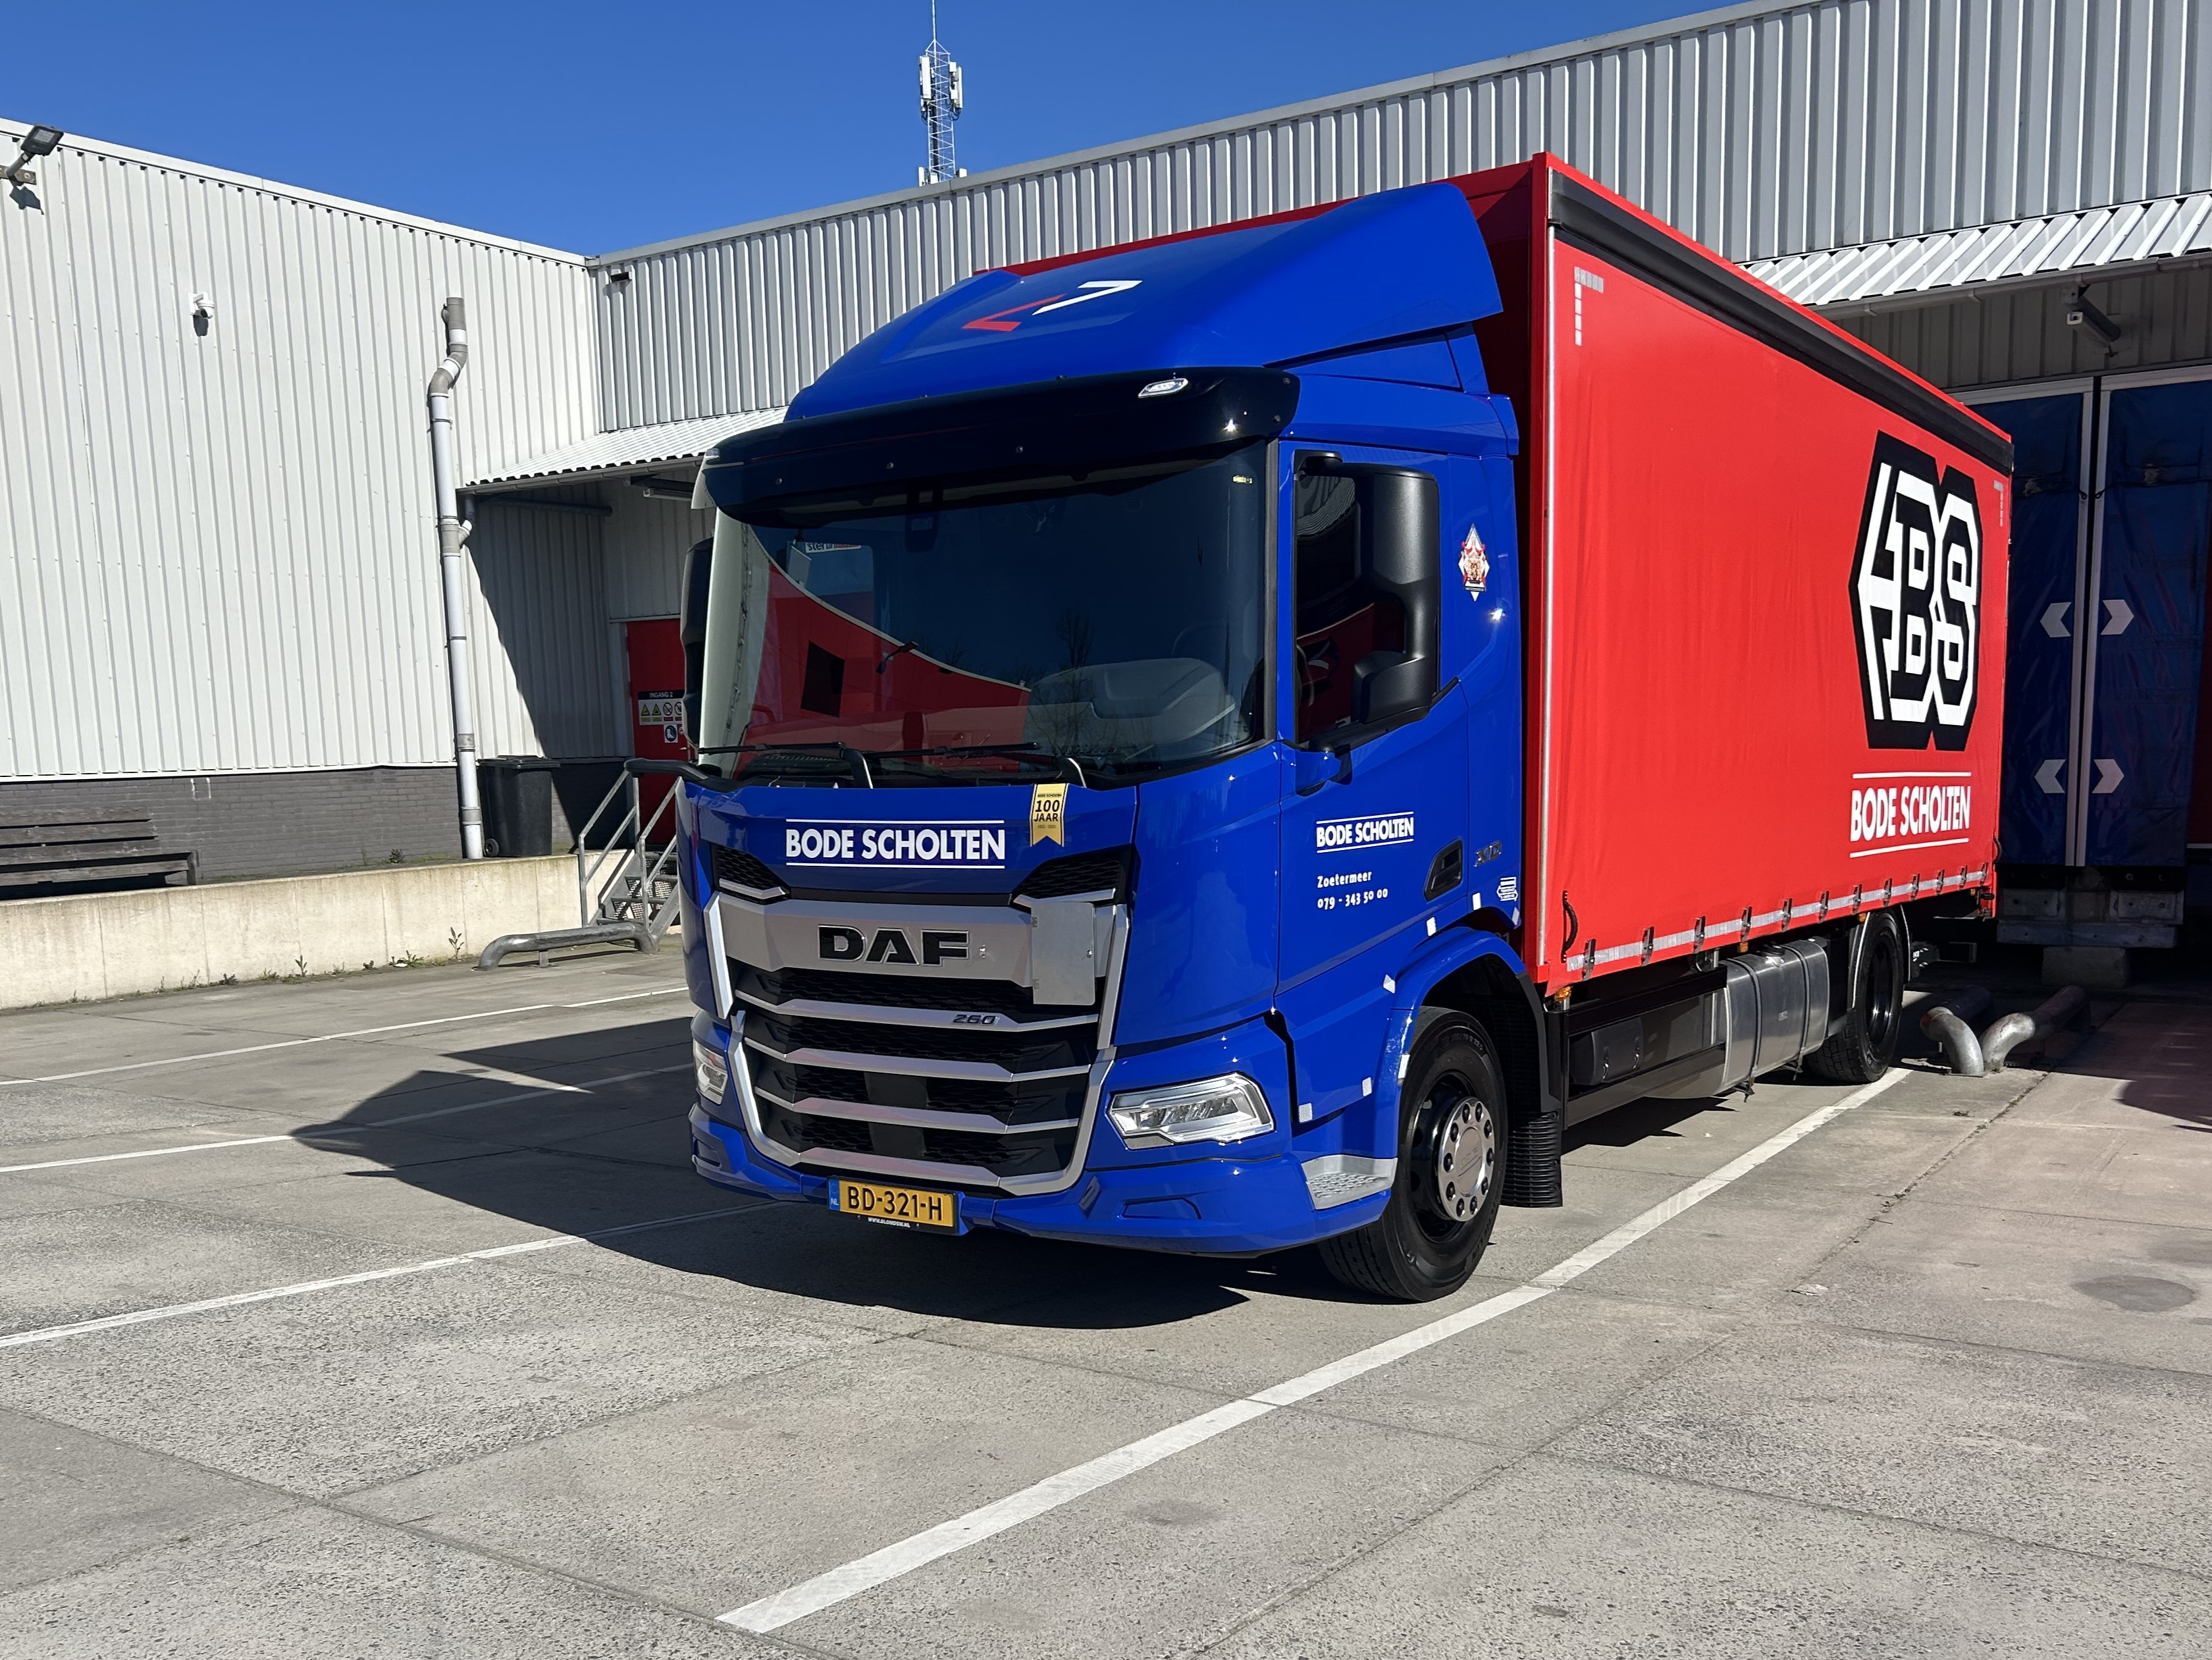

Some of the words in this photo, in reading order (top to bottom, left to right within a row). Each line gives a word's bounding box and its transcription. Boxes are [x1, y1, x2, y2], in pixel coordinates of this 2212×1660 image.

[1034, 813, 1059, 822] JAAR
[1035, 799, 1060, 813] 100
[1850, 788, 1897, 842] BODE
[1900, 785, 1971, 836] SCHOLTEN
[786, 829, 854, 859] BODE
[862, 828, 1005, 860] SCHOLTEN
[1317, 824, 1352, 847] BODE
[1355, 817, 1414, 843] SCHOLTEN
[1317, 871, 1372, 888] Zoetermeer
[1317, 897, 1335, 910] 079
[1345, 892, 1361, 907] 343
[1363, 890, 1374, 904] 50
[1377, 888, 1388, 899] 00
[818, 924, 970, 967] DAF
[953, 1014, 997, 1025] 260
[831, 1197, 839, 1206] NL
[848, 1186, 943, 1221] BD-321-H
